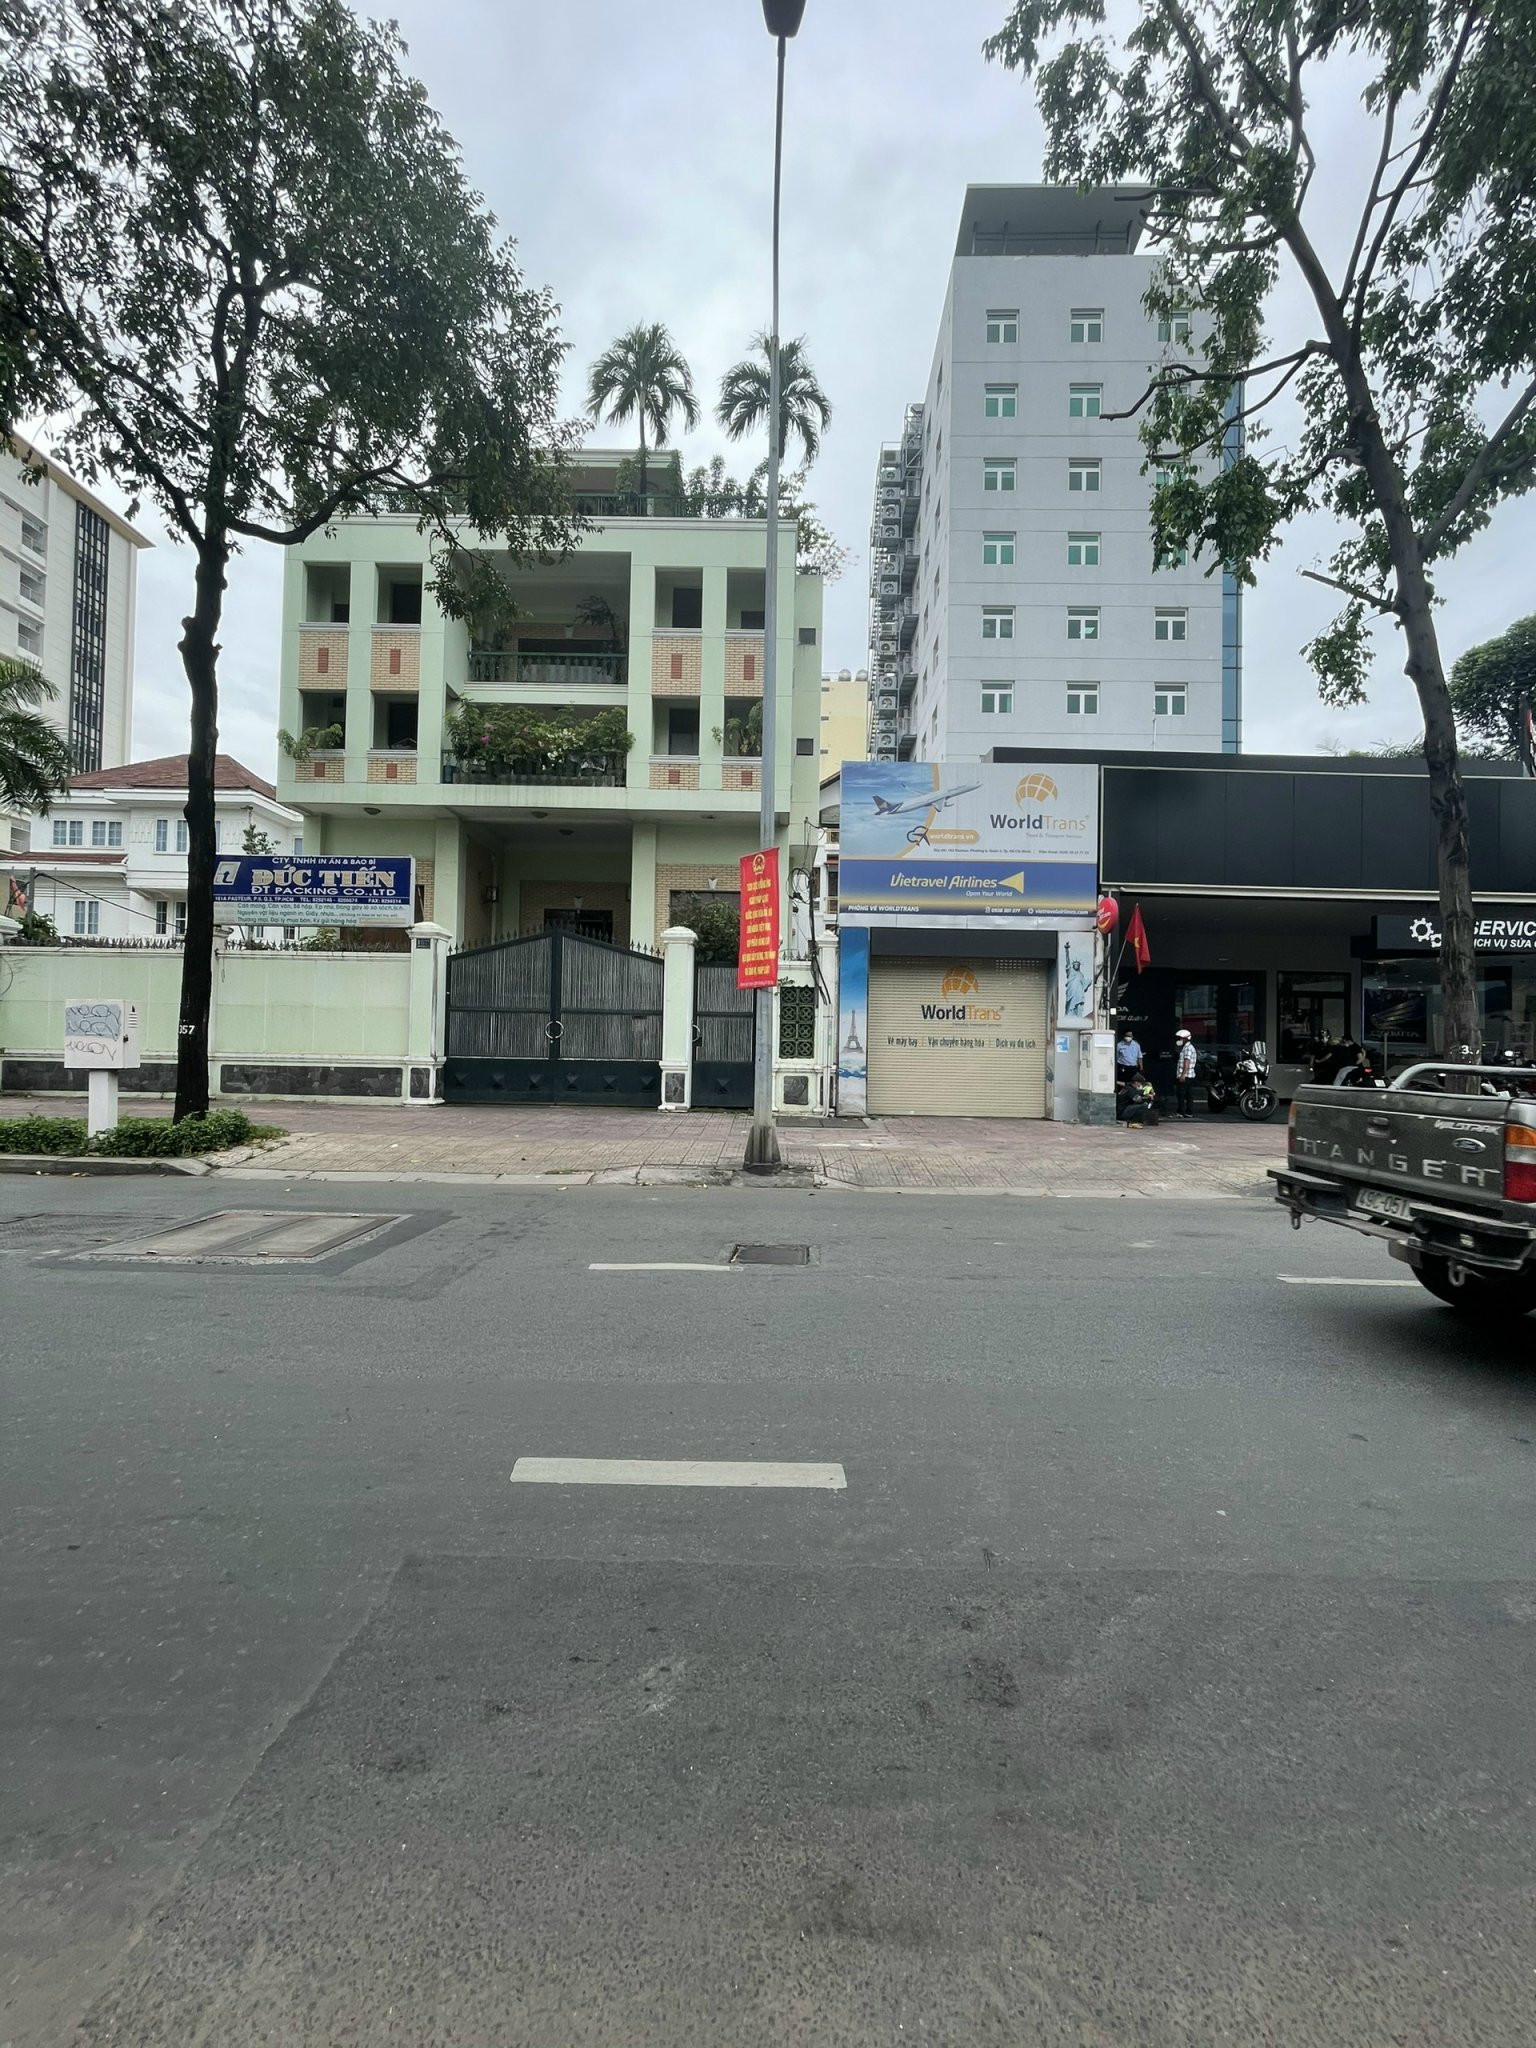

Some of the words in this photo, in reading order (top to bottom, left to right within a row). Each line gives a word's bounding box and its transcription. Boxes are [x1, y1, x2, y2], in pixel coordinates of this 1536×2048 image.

[251, 864, 312, 887] ĐỨC
[318, 866, 396, 888] TIẾN
[890, 872, 948, 887] Vietravel
[948, 875, 998, 890] Airlines
[251, 886, 270, 894] ĐT
[275, 887, 339, 895] PACKING
[343, 888, 396, 896] CO.,LTD
[1474, 920, 1536, 936] ERVIC
[1494, 938, 1508, 950] VỤ
[1510, 938, 1532, 948] SỬA
